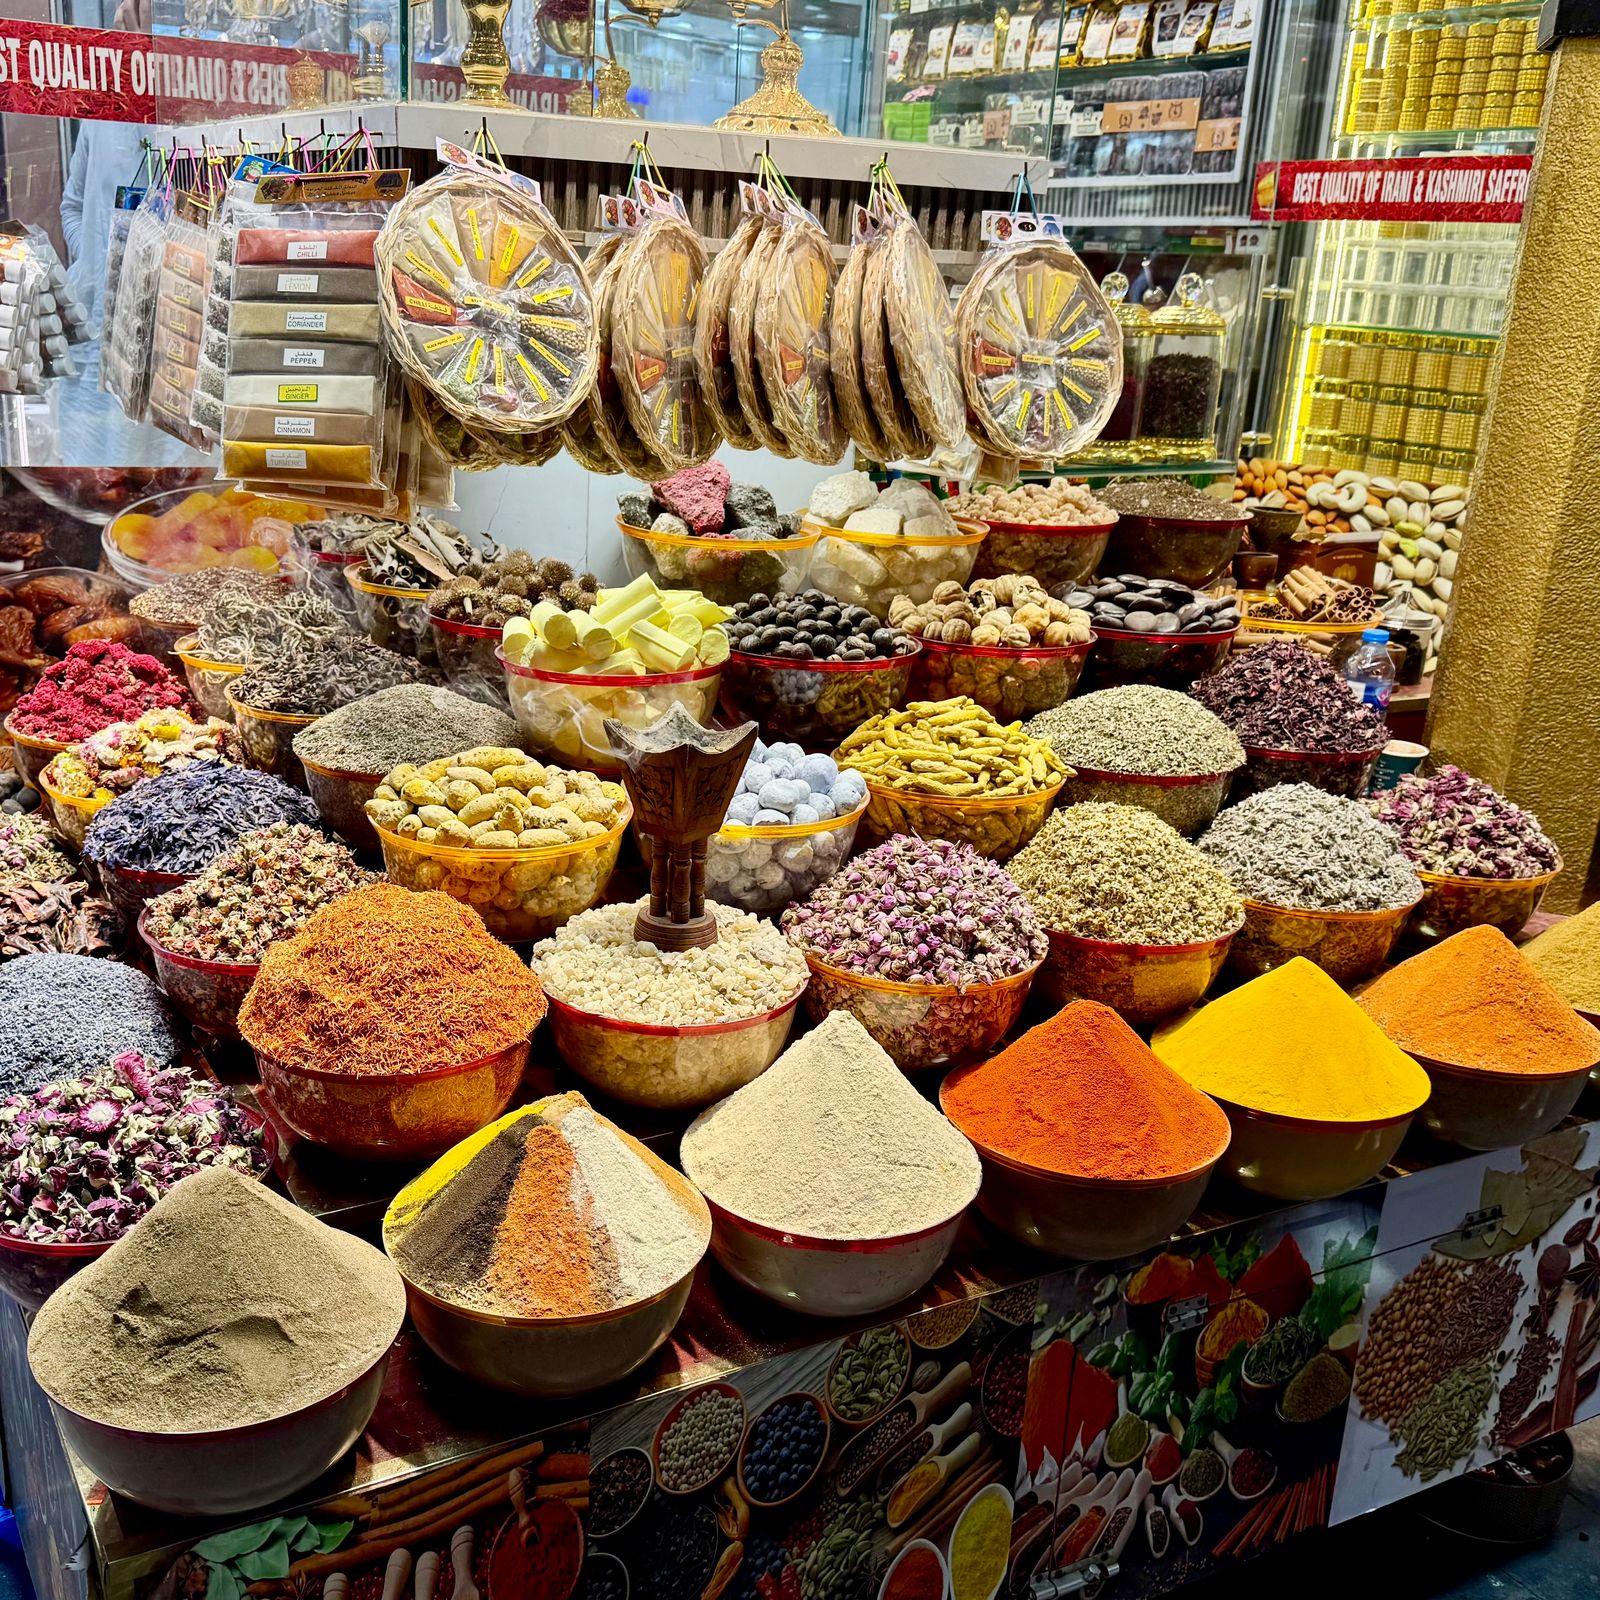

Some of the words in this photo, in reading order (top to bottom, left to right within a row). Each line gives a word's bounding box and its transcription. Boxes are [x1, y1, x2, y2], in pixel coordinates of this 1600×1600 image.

[28, 39, 123, 93] QUALITY
[1292, 171, 1321, 203] BEST
[1320, 171, 1365, 206] QUALITY
[1364, 170, 1381, 203] OF
[1380, 170, 1415, 203] IRANI
[1413, 169, 1424, 203] &
[1425, 169, 1486, 203] KASHMIRI
[287, 320, 324, 328] CORIANDER
[290, 357, 317, 365] PEPPER
[285, 392, 310, 400] GINGER
[276, 426, 311, 434] CINNAMON
